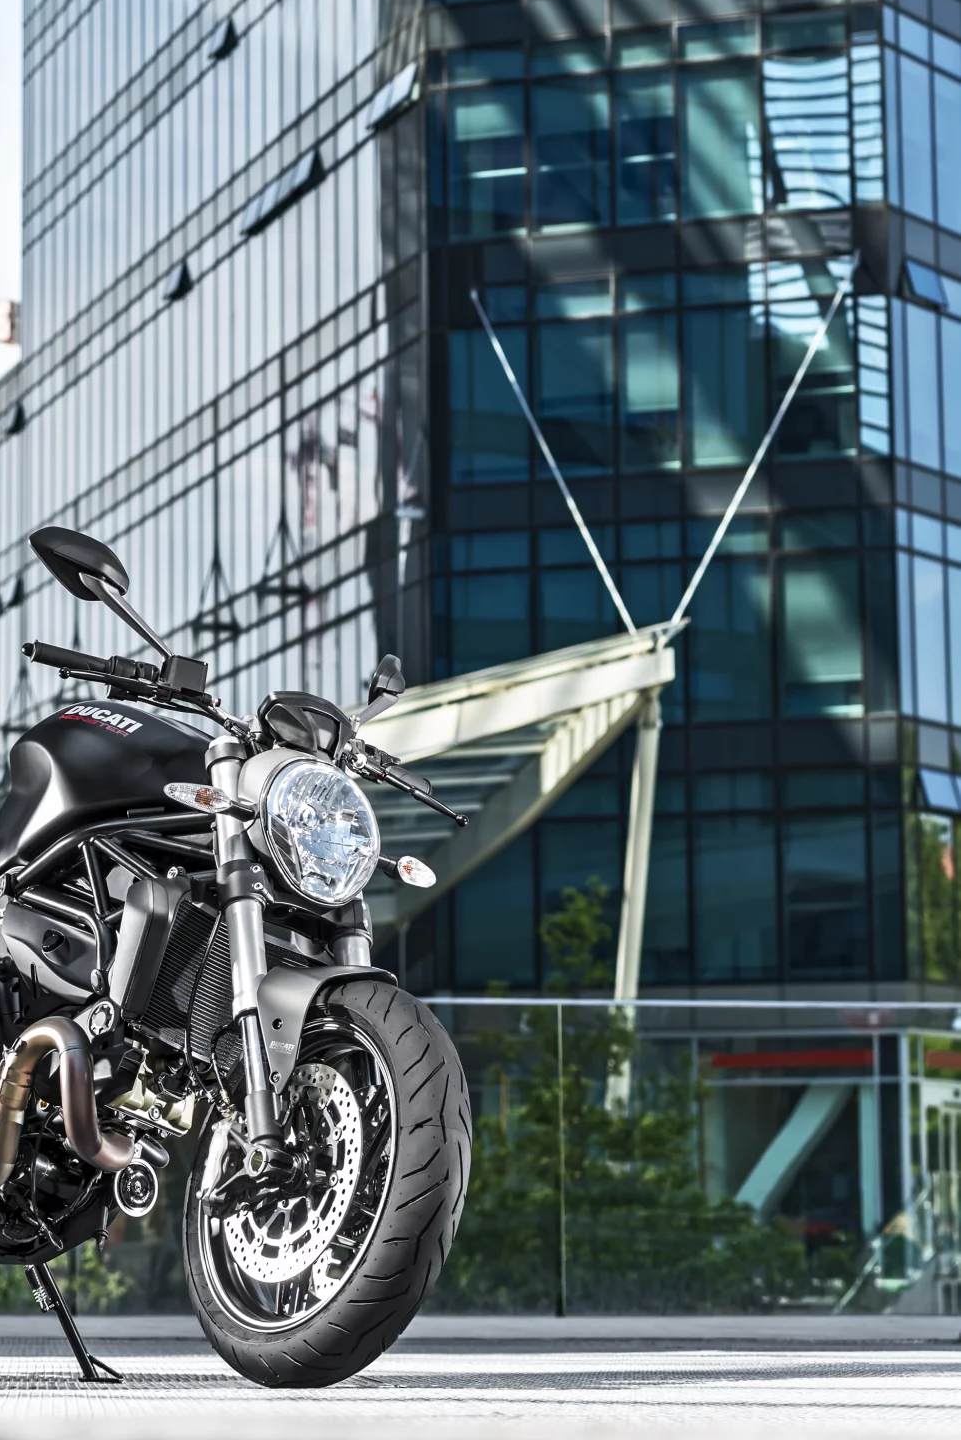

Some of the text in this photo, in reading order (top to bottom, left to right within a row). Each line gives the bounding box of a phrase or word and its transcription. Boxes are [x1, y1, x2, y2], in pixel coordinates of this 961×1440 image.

[59, 714, 129, 737] MONSTER
[64, 705, 143, 734] DUCATI
[270, 1040, 295, 1050] DUCATI
